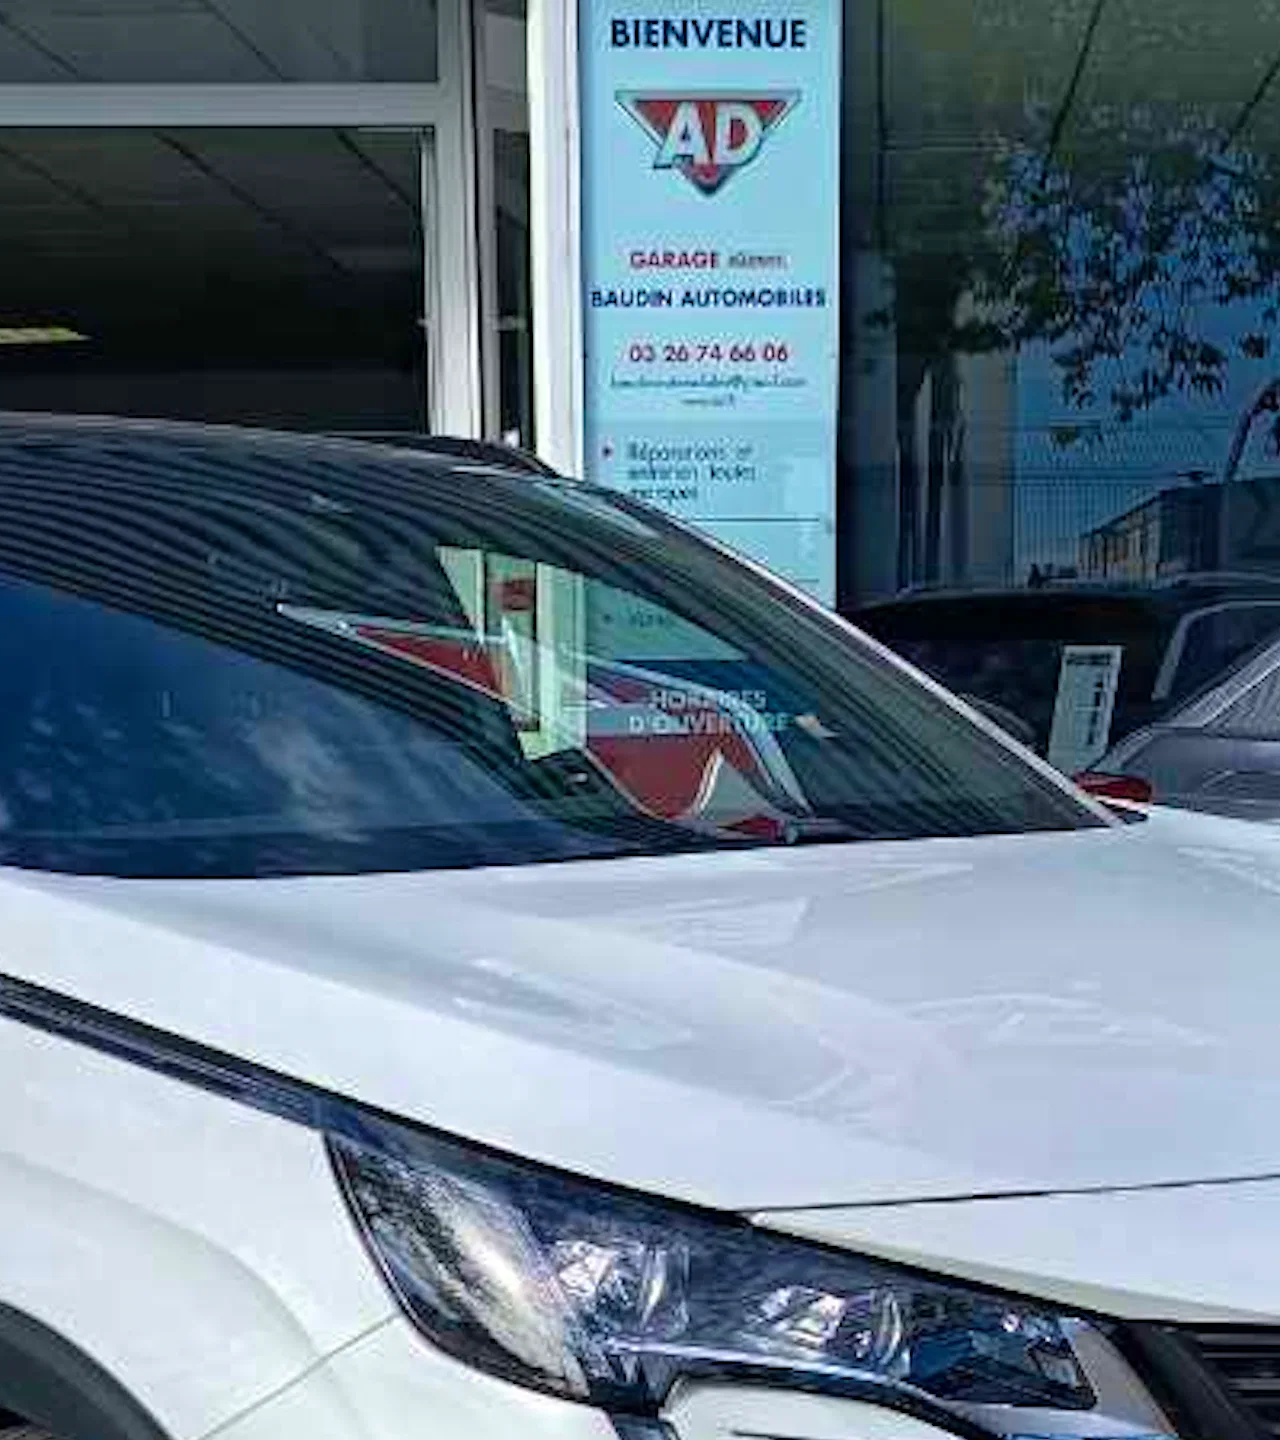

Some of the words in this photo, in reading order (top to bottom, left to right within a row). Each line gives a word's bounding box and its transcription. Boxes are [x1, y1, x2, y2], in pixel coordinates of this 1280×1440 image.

[610, 19, 807, 48] BIENVENUE
[653, 100, 764, 169] AD
[630, 251, 719, 269] GARAGE
[591, 289, 671, 308] BAUDIN
[681, 288, 825, 307] AUTOMOBILES
[629, 344, 655, 362] 03
[663, 344, 689, 362] 26
[696, 344, 721, 362] 74
[729, 344, 756, 362] 66
[762, 344, 789, 362] 06
